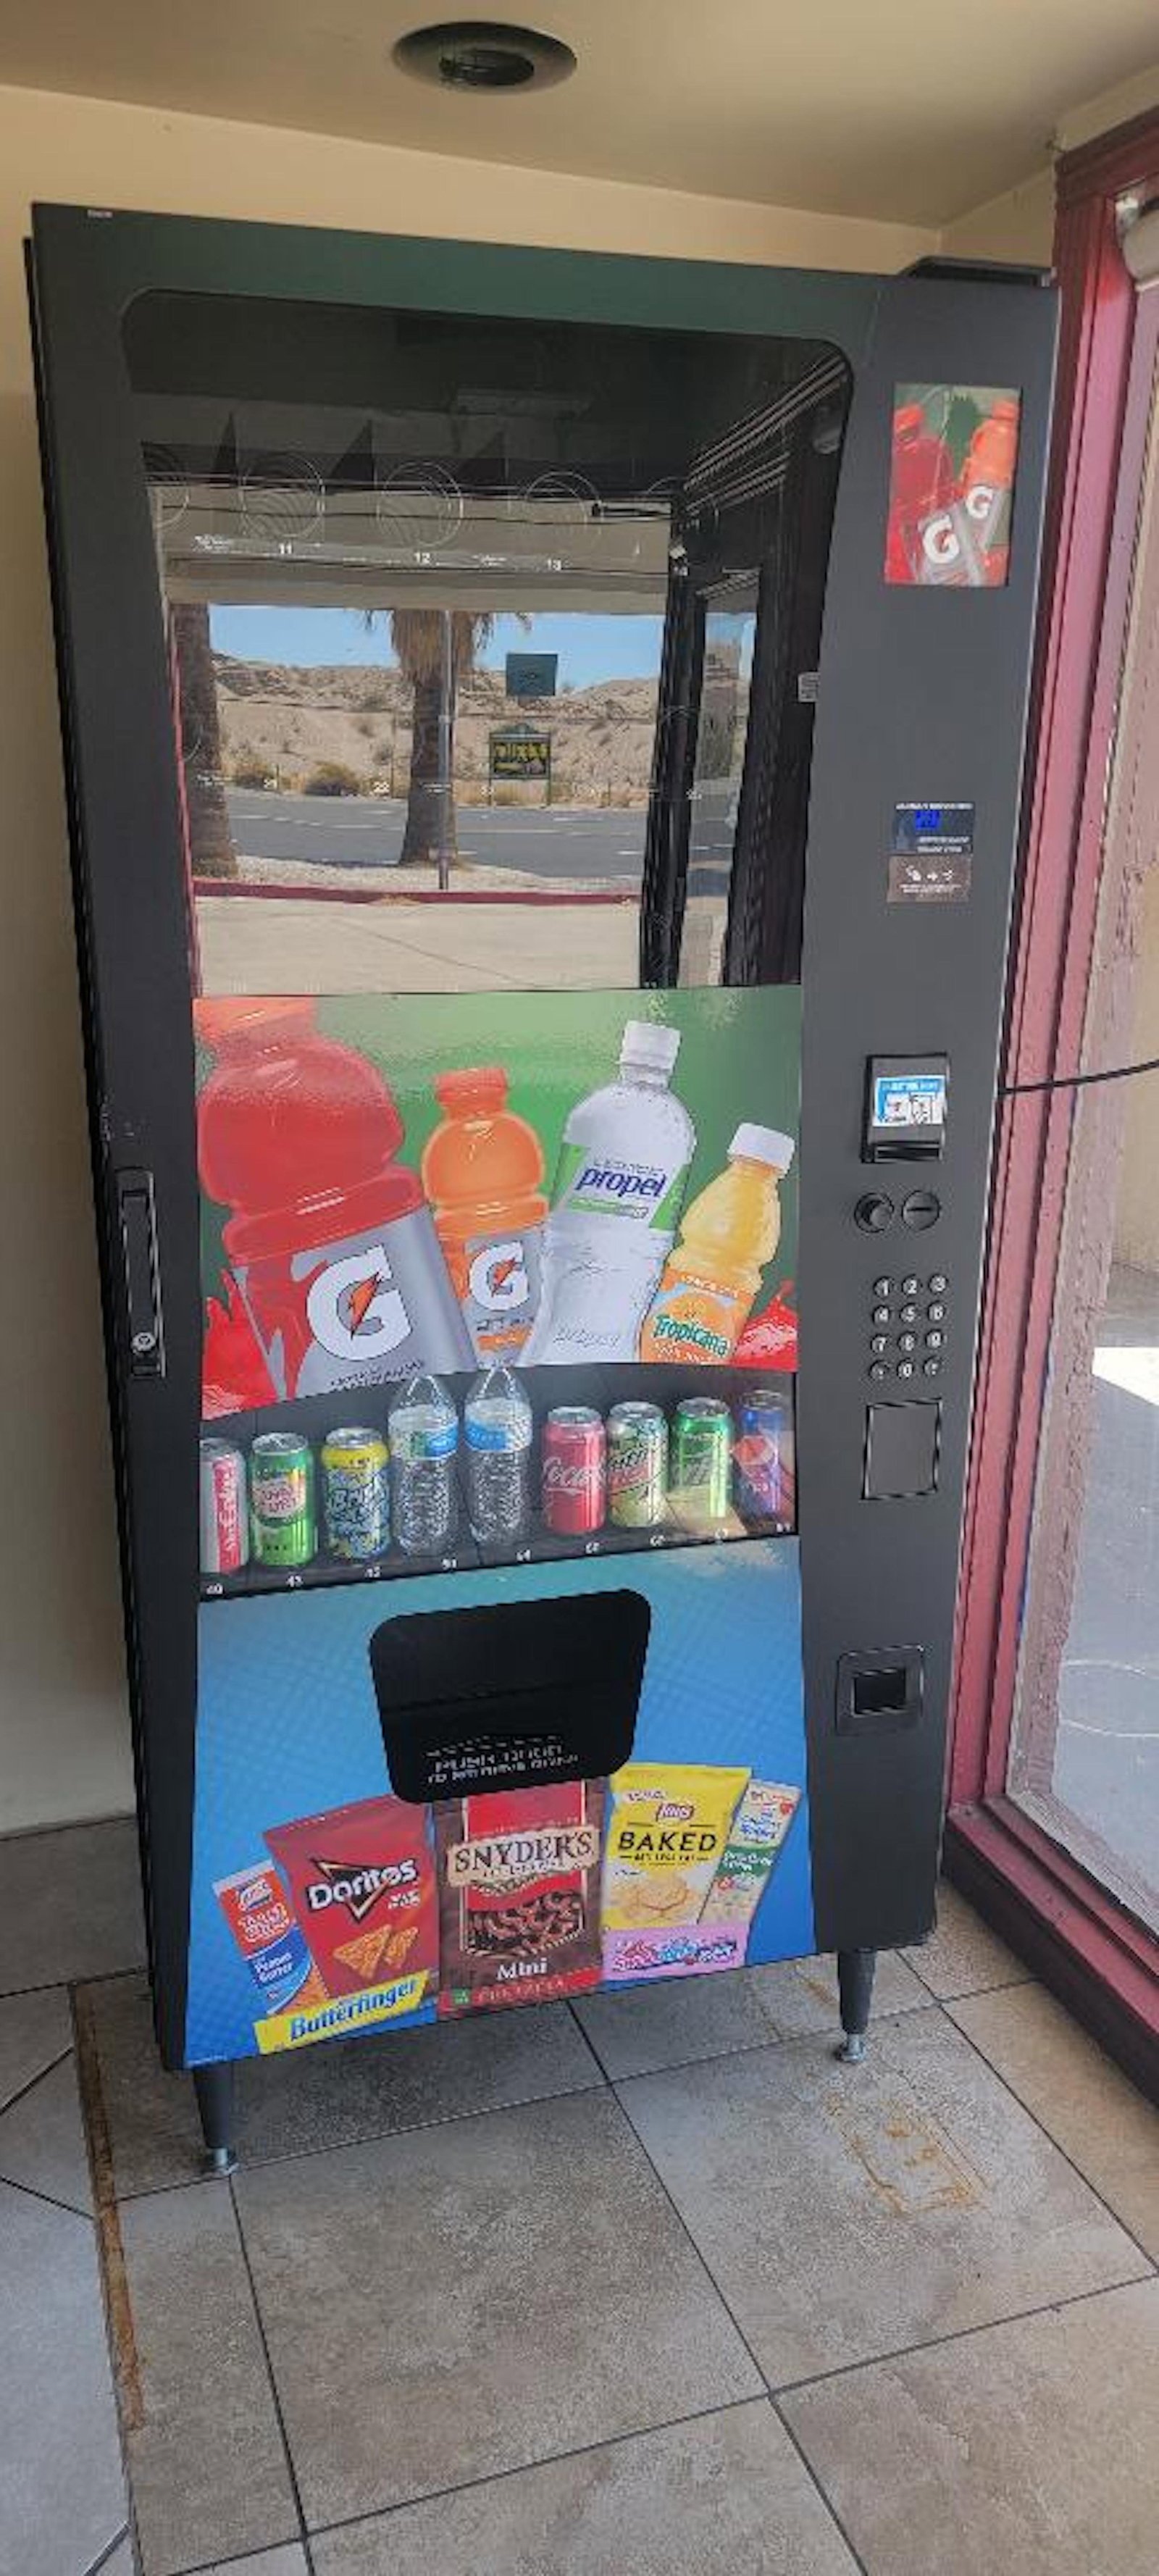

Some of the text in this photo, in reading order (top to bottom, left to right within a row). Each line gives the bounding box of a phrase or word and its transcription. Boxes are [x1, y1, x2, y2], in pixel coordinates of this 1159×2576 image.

[965, 486, 994, 519] G
[278, 544, 294, 555] 11
[414, 553, 430, 564] 12
[923, 514, 960, 563] G
[574, 1168, 666, 1197] propel
[469, 1241, 530, 1311] G
[306, 1244, 412, 1362] G
[653, 1313, 729, 1357] Tropicana
[455, 1831, 593, 1873] SNYDER'S
[619, 1831, 717, 1852] BAKED
[307, 1858, 418, 1911] Doritos
[495, 1957, 548, 1981] Mini
[289, 1978, 419, 2041] Butterfinger
